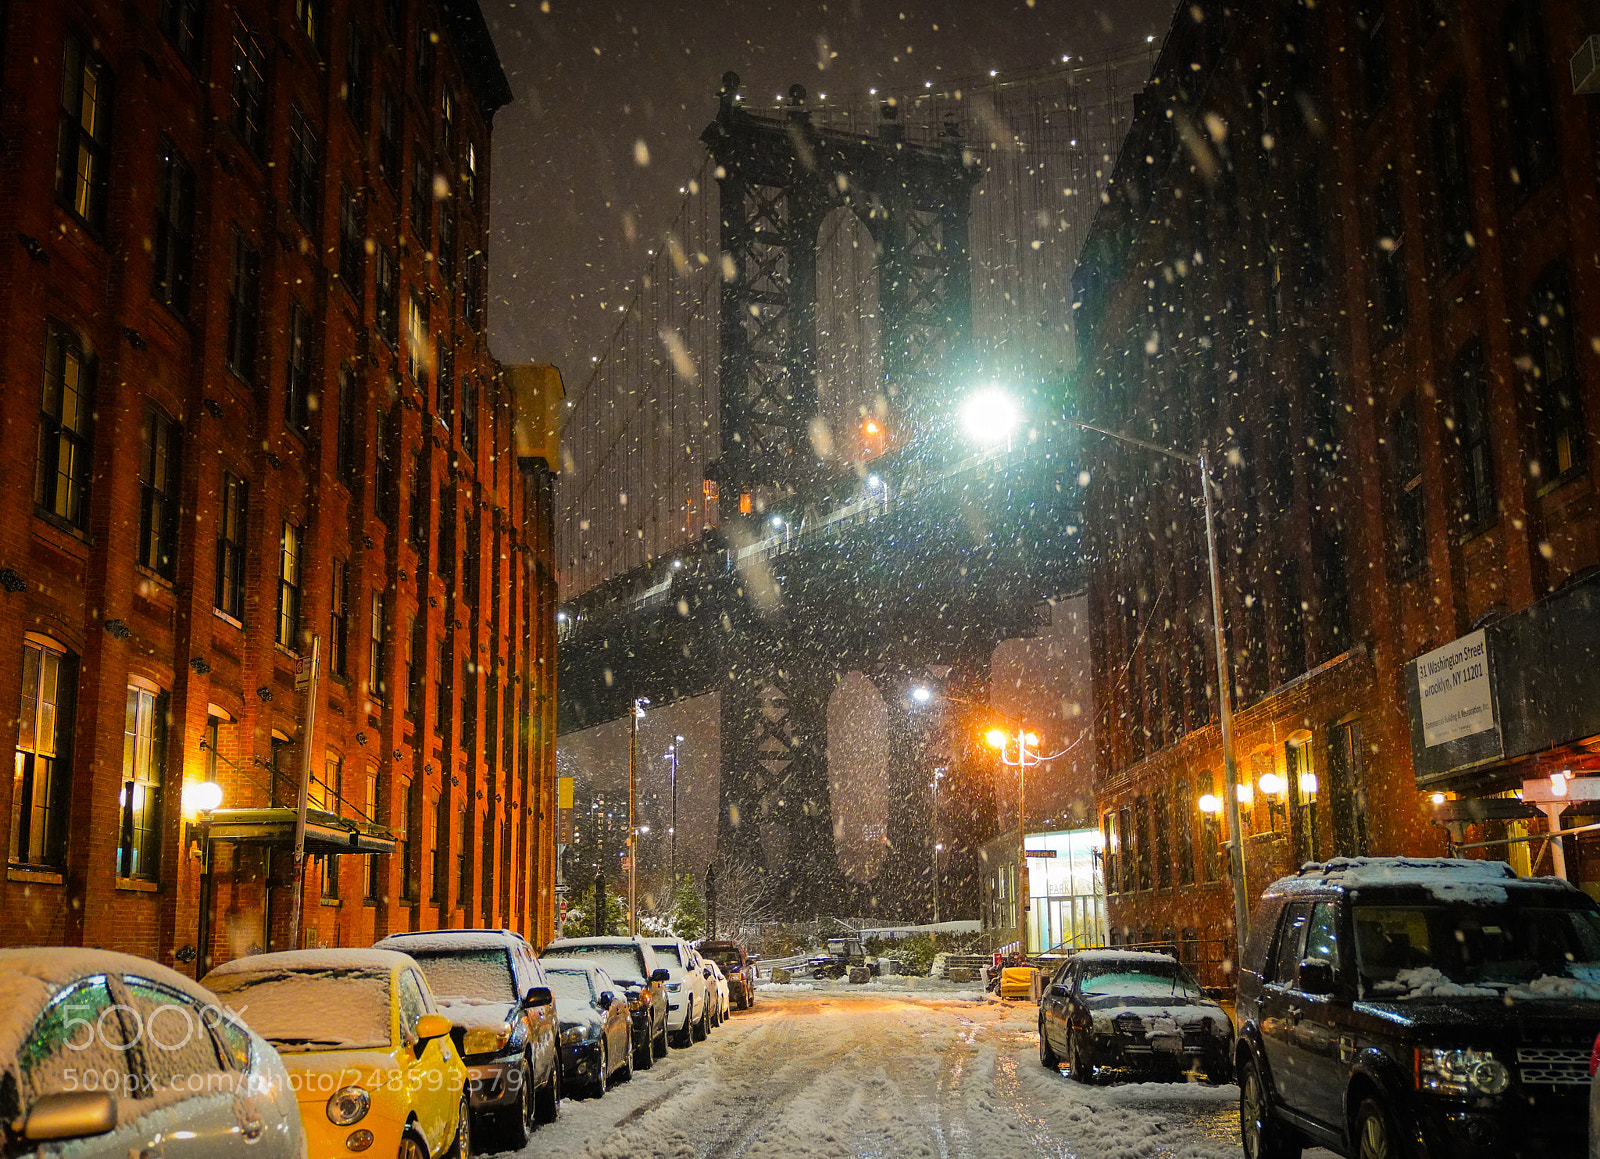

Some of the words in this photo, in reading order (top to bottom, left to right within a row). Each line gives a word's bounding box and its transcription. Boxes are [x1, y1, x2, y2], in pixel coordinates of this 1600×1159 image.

[1420, 664, 1428, 679] 31
[1427, 653, 1464, 675] Washington
[1463, 642, 1484, 661] Street
[1452, 670, 1462, 687] NY
[1463, 663, 1484, 683] 11201
[1520, 1032, 1592, 1044] LAND
